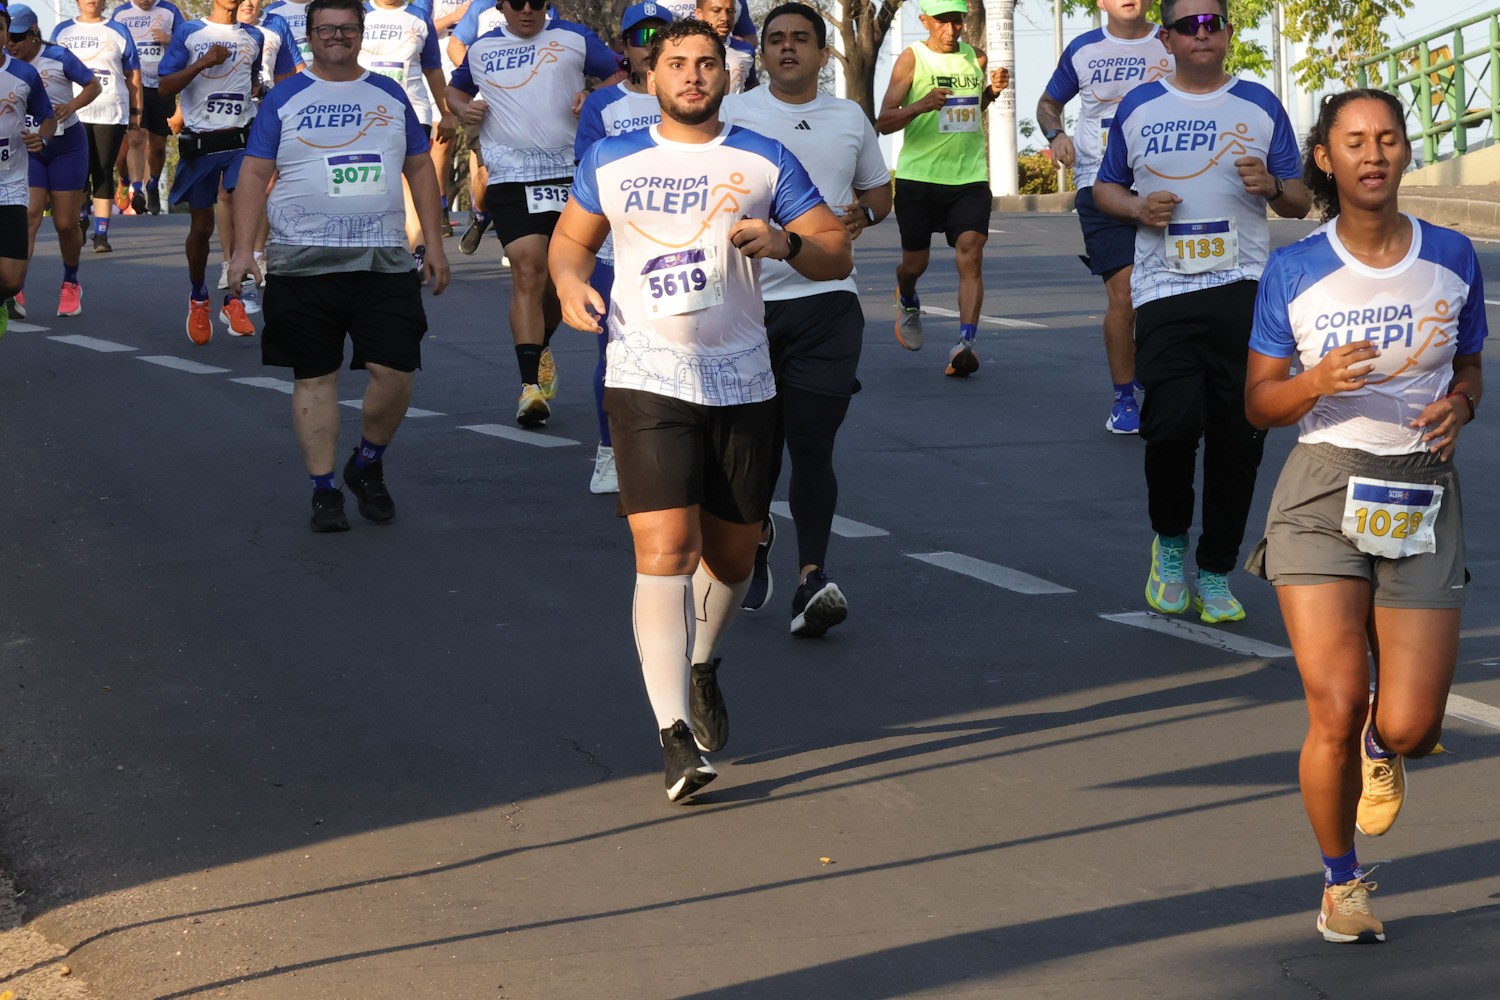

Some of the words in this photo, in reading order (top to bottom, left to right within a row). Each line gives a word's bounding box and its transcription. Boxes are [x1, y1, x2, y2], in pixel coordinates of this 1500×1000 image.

[480, 44, 536, 62] CORRIDA
[484, 52, 536, 74] ALEPI
[1088, 57, 1146, 70] CORRIDA
[1090, 67, 1146, 85] ALEPI
[206, 101, 242, 116] 5739
[296, 104, 362, 116] CORRIDA
[946, 108, 976, 122] 1191
[296, 113, 362, 131] ALEPI
[614, 114, 662, 130] CORRID
[1140, 120, 1217, 138] CORRIDA
[1144, 132, 1217, 158] ALEPI
[332, 166, 382, 184] 3077
[620, 174, 708, 192] CORRIDA
[533, 187, 569, 202] 5313
[624, 188, 708, 215] ALEPI
[1176, 237, 1224, 260] 1133
[648, 267, 708, 300] 5619
[1315, 304, 1413, 332] CORRIDA
[1355, 508, 1424, 539] 1028
